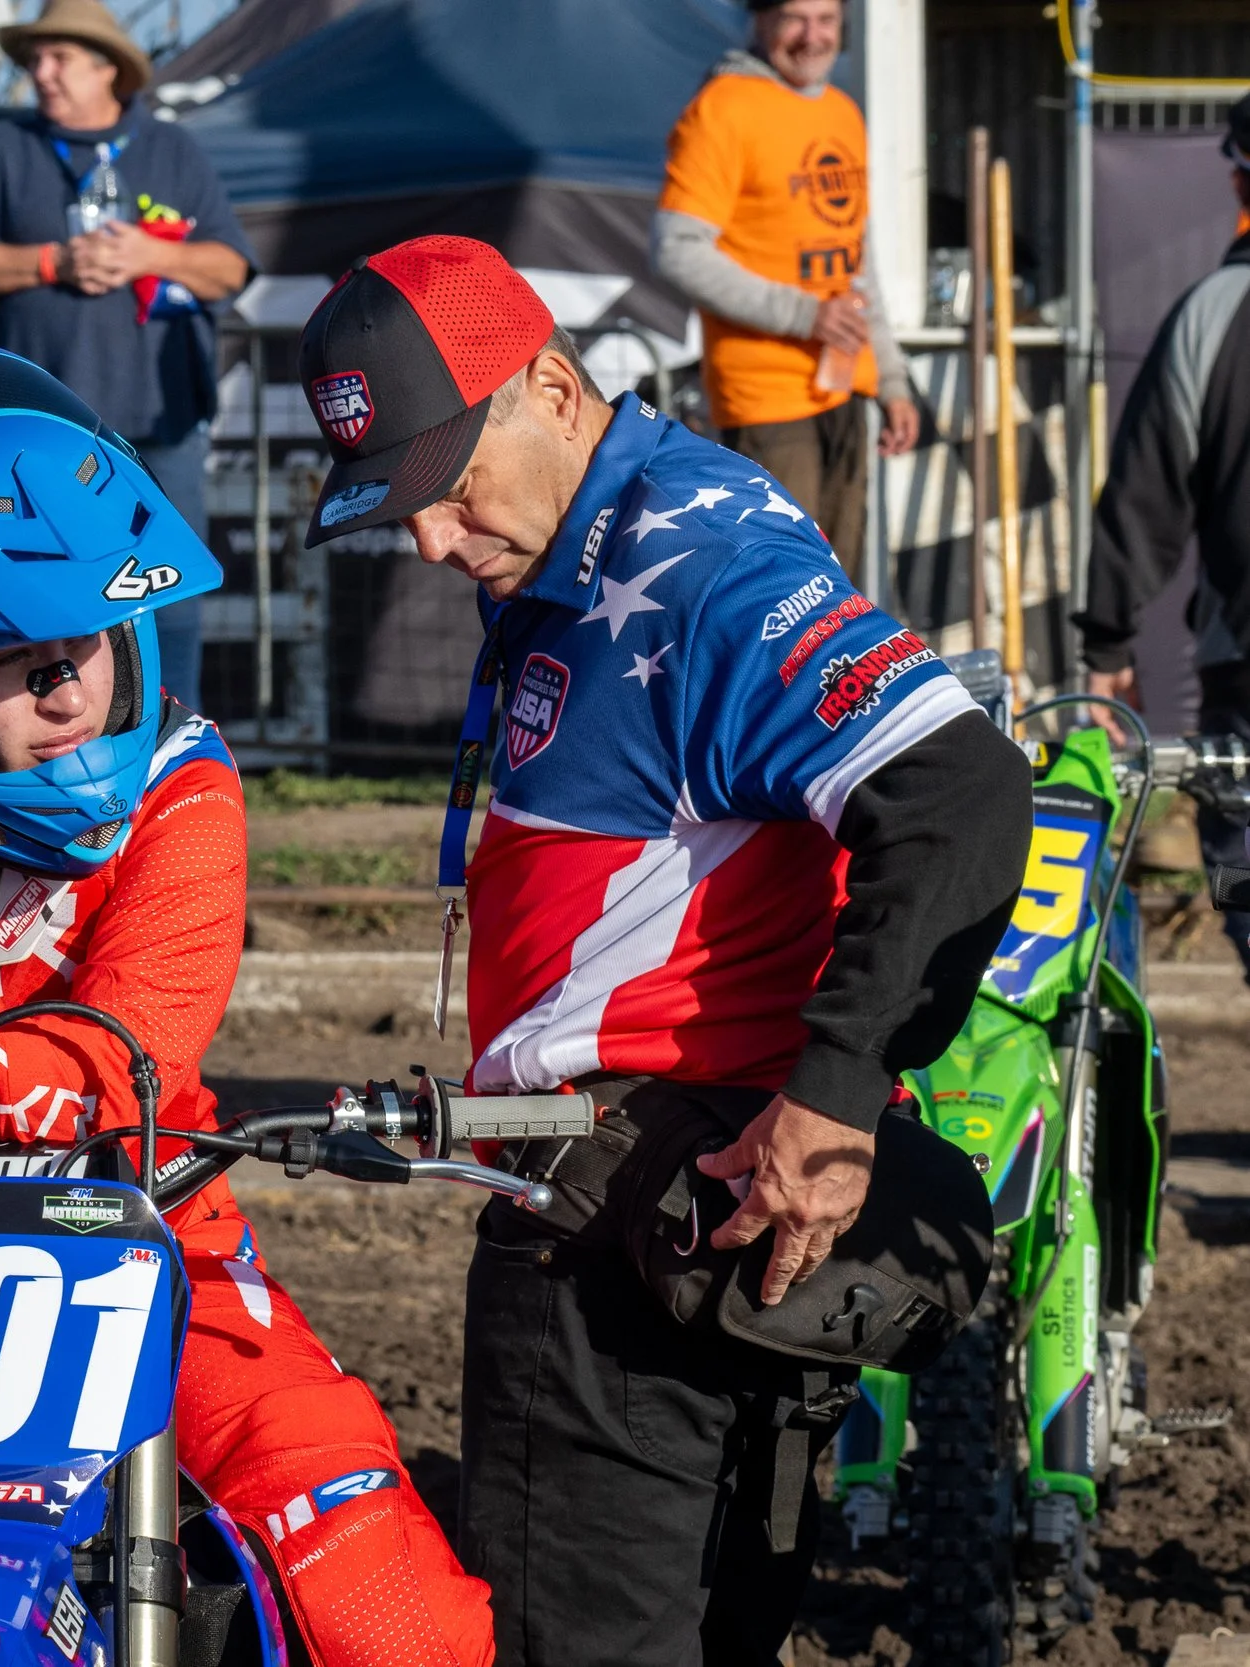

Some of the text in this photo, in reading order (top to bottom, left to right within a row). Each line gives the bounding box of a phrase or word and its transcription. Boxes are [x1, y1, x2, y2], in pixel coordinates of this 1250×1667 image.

[320, 394, 370, 421] USA
[323, 497, 380, 522] CAMBRIDGE
[576, 507, 615, 585] USA
[101, 554, 182, 602] 6D
[511, 688, 553, 731] USA
[13, 901, 41, 938] NUTRITION
[42, 1207, 123, 1221] MOTOCROSS
[119, 1248, 162, 1264] AMA
[1041, 1306, 1061, 1338] SF
[1063, 1275, 1076, 1368] LOGISTICS
[46, 1584, 88, 1661] USA
